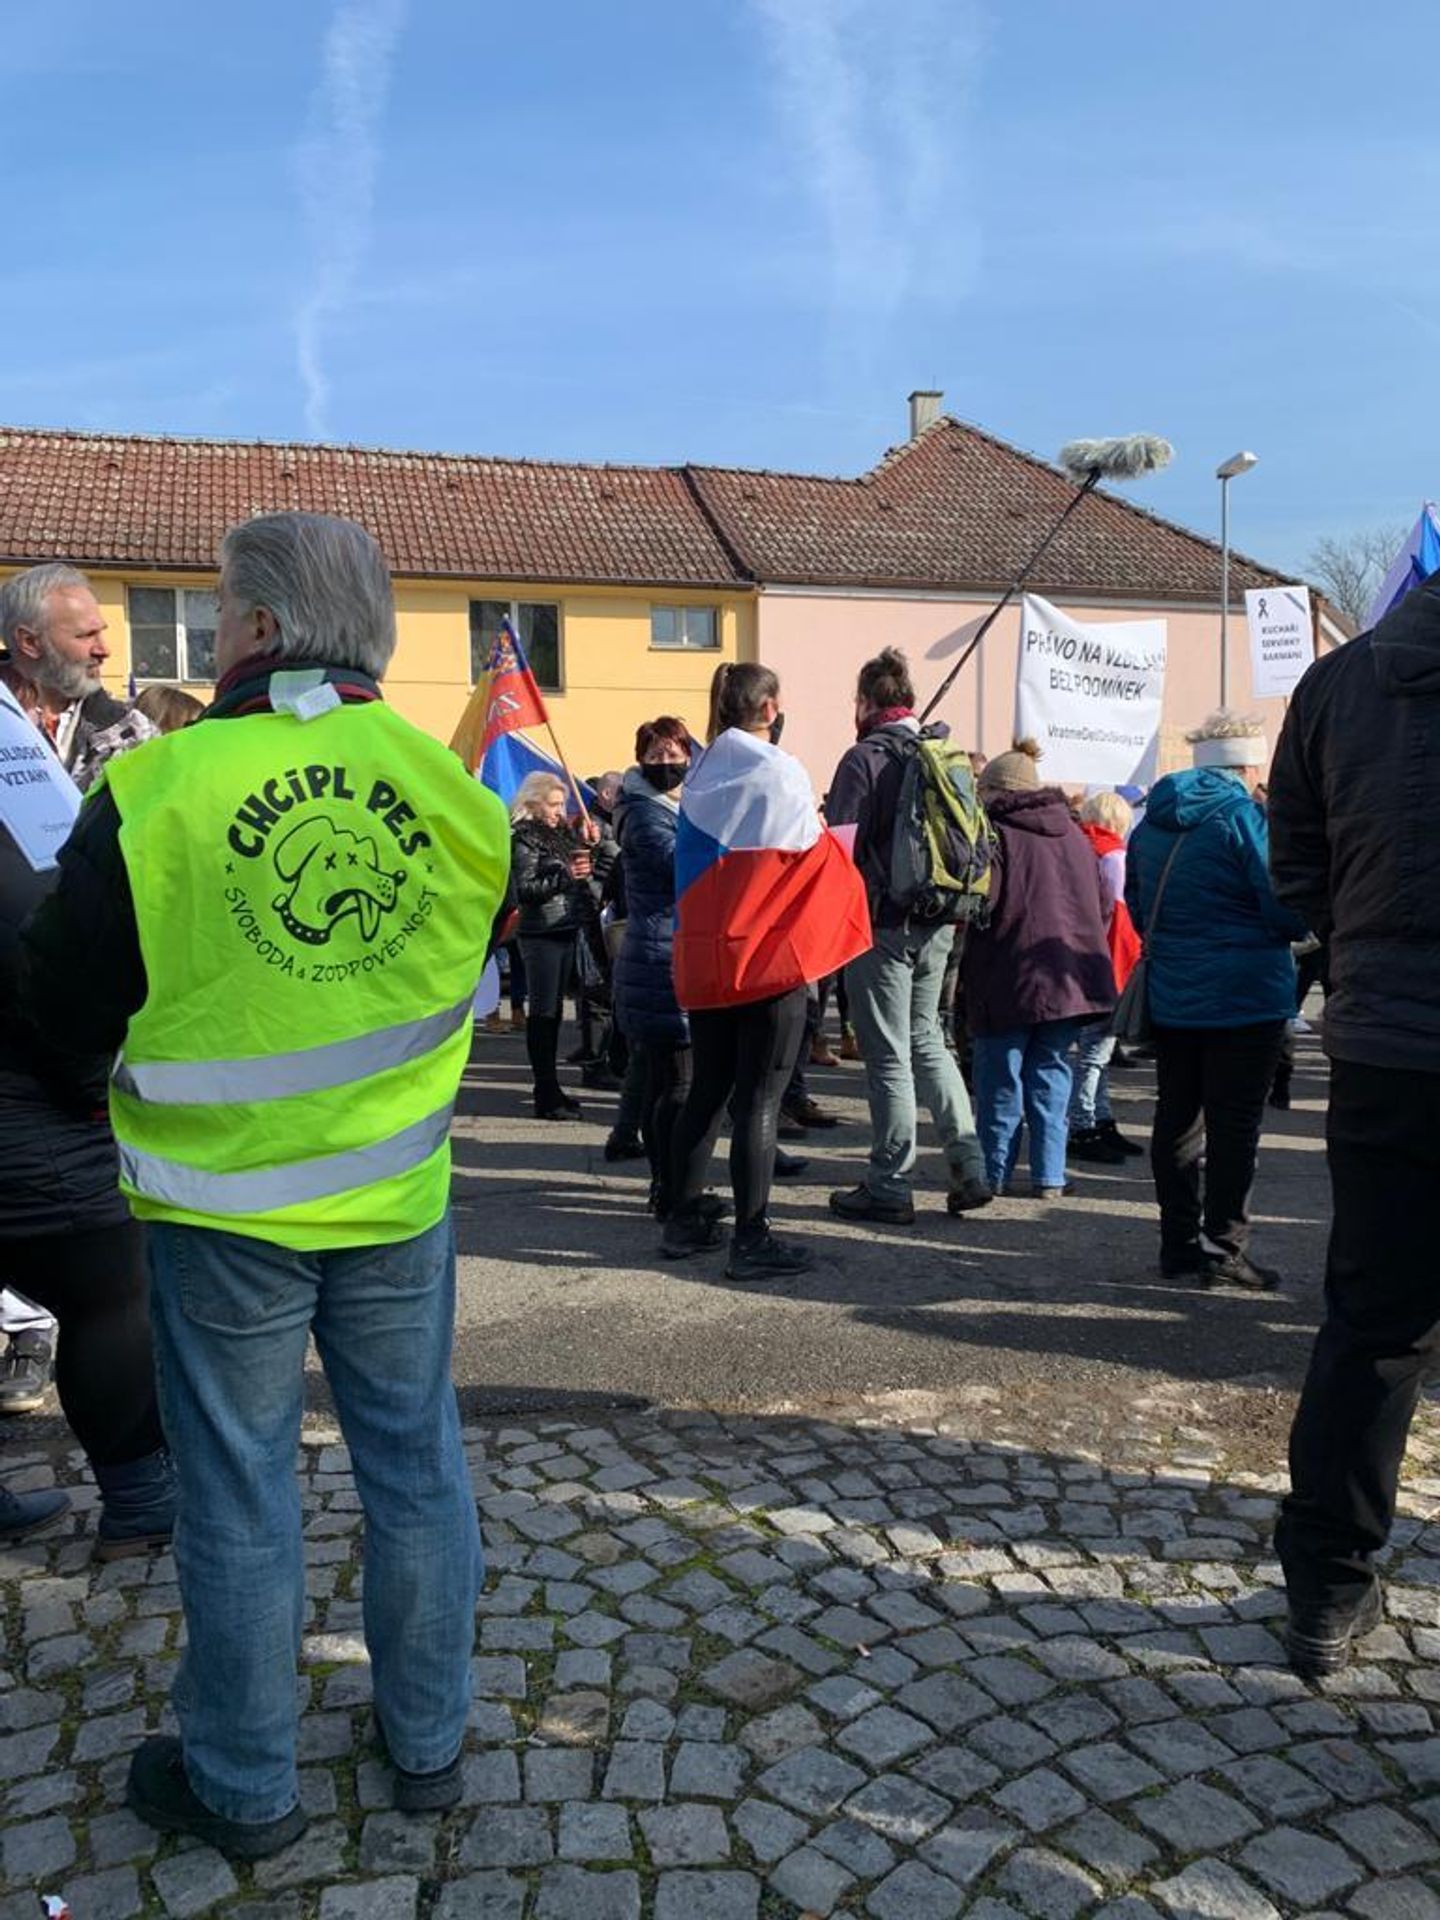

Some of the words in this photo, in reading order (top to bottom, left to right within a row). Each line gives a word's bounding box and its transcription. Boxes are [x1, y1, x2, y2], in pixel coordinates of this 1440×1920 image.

[1079, 640, 1102, 664] NA
[1074, 674, 1147, 701] PODMÍNEK
[366, 780, 432, 857] PES
[224, 887, 295, 977] SVOBODA
[311, 885, 439, 983] ZODPOVĚDNOST
